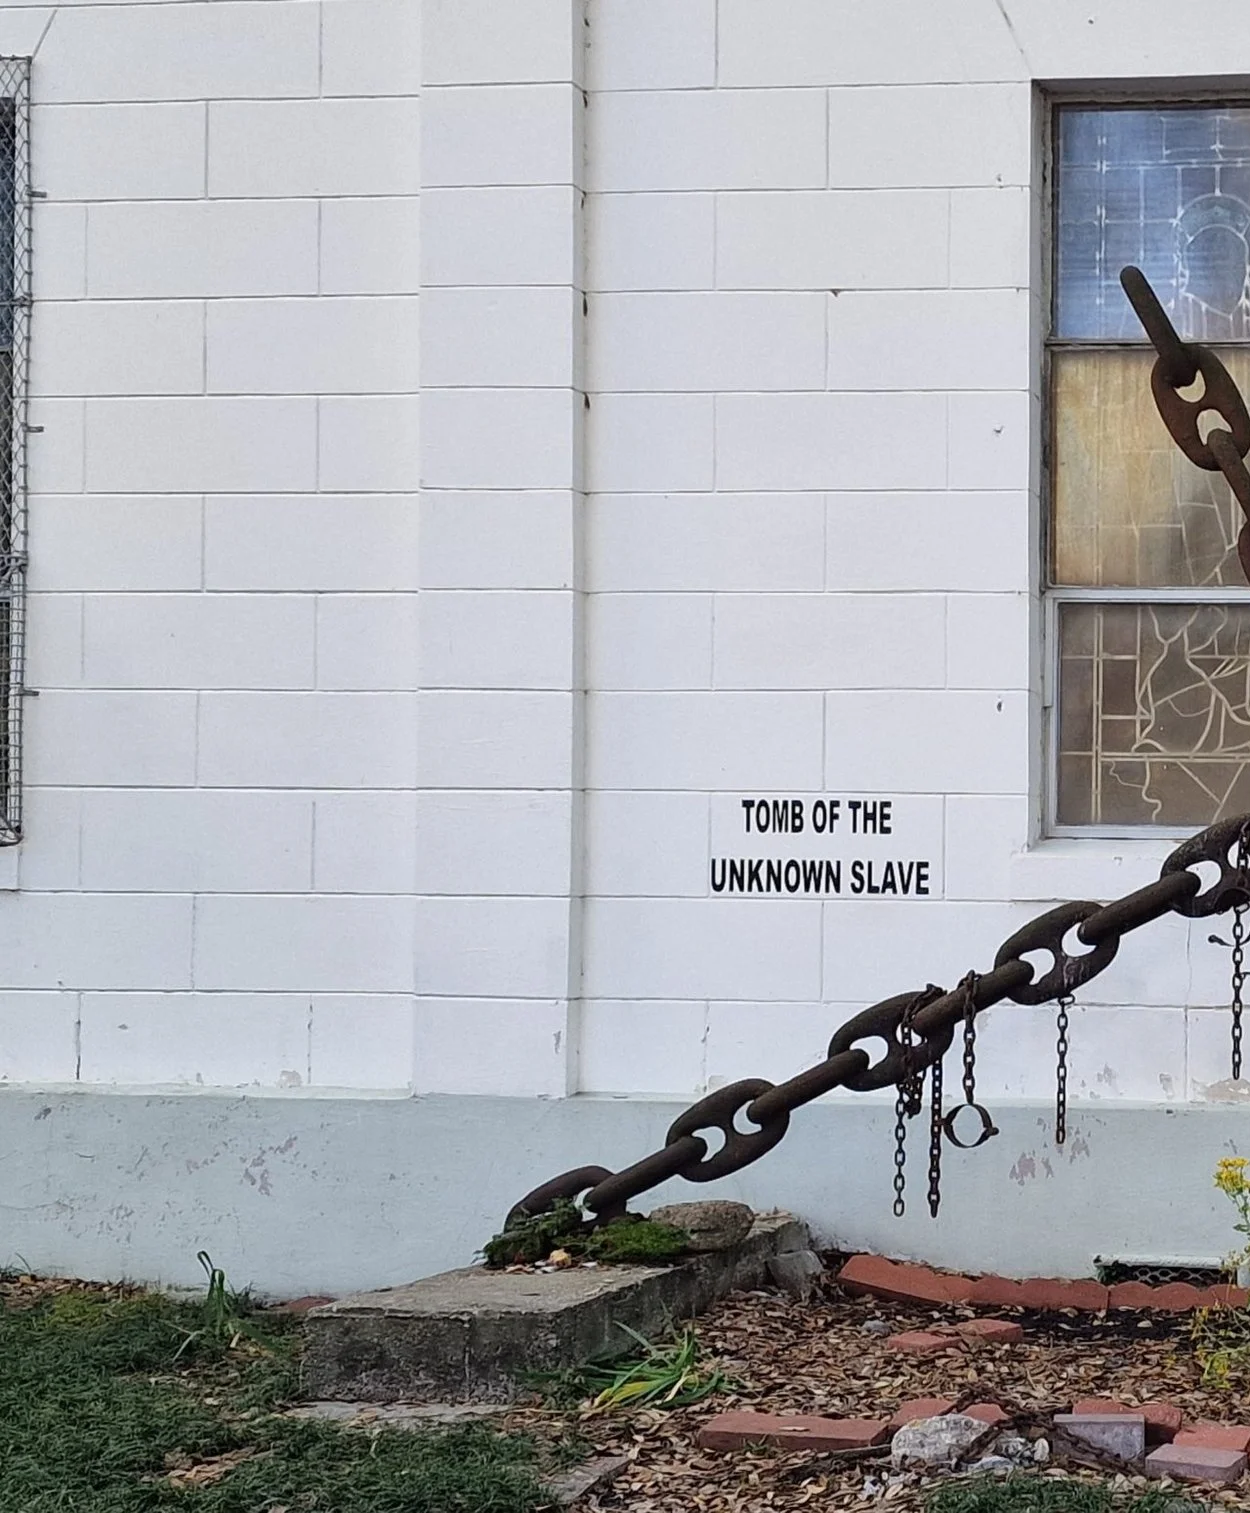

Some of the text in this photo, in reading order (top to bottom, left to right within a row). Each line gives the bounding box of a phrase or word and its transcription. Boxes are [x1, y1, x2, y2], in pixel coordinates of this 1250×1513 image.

[741, 799, 892, 834] TOMB OF THE
[711, 858, 929, 895] UNKNOWN SLAVE
